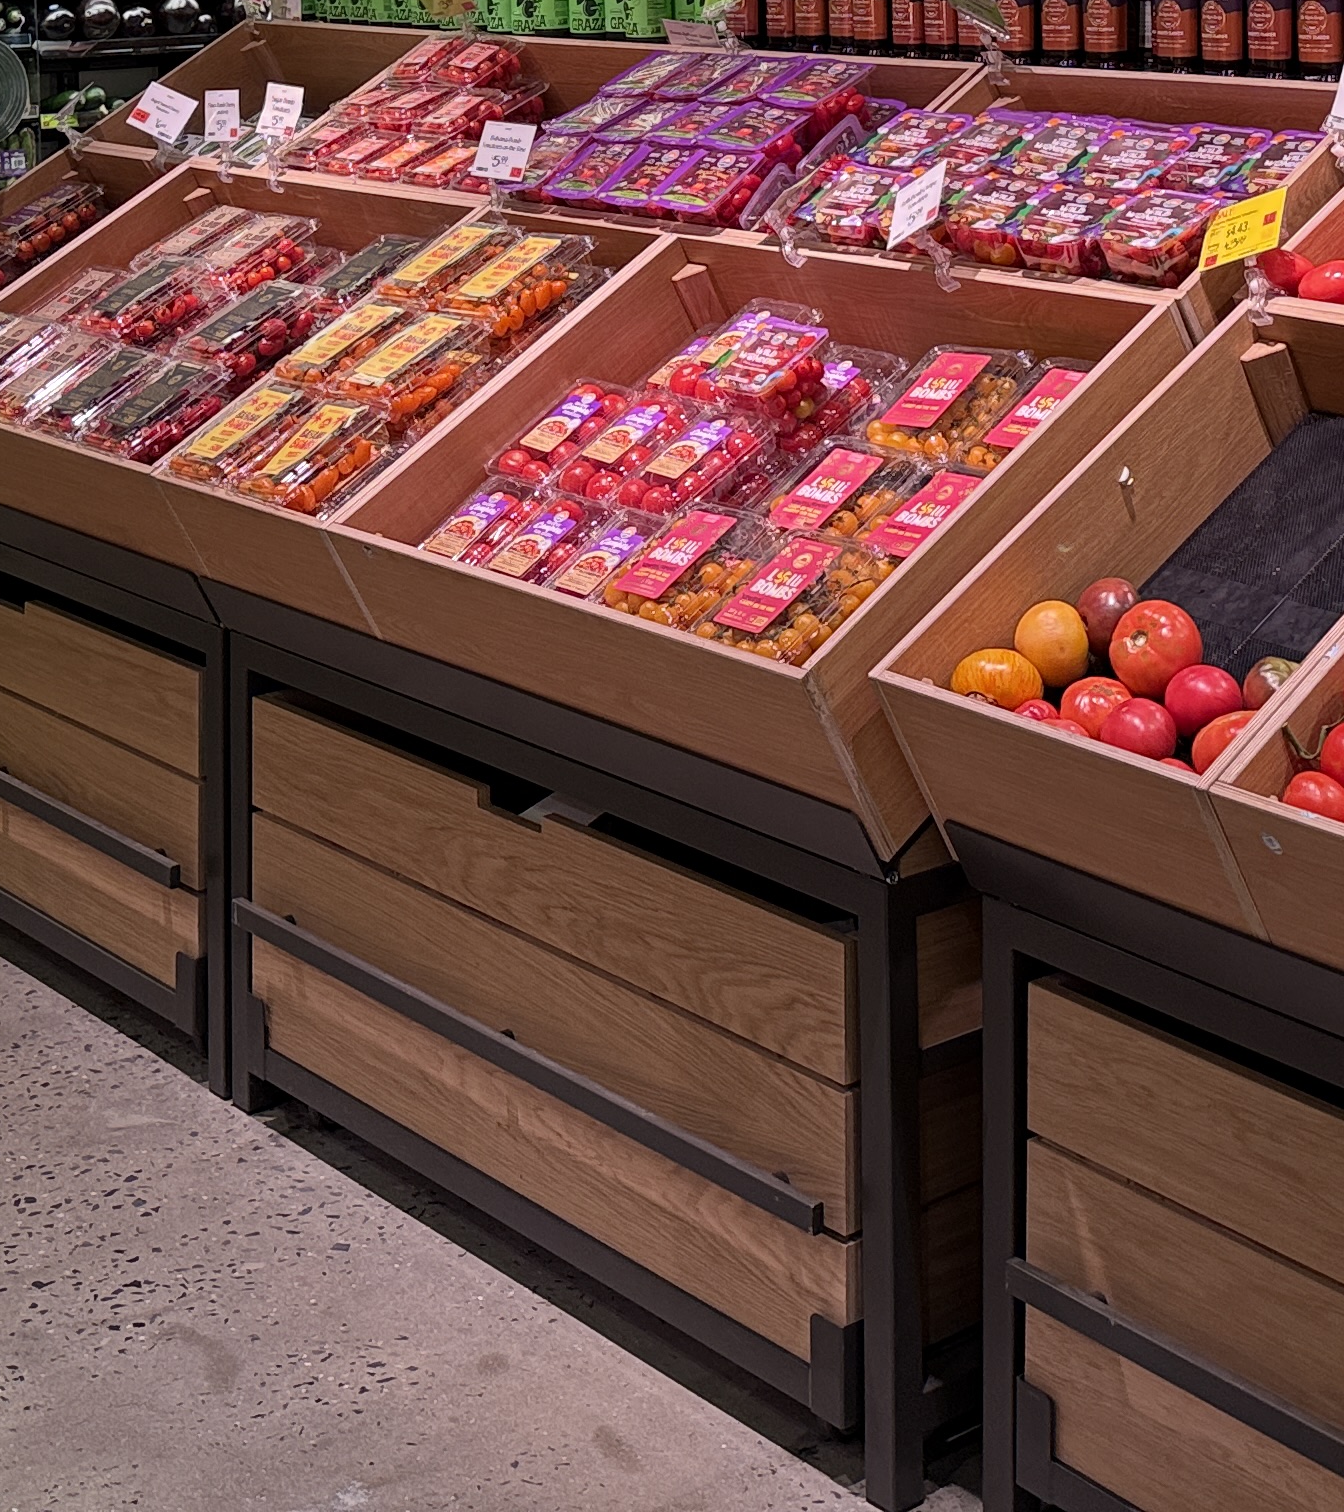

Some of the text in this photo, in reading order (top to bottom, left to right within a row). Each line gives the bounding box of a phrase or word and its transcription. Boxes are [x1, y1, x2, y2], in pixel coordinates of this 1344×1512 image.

[909, 385, 957, 402] BOMBS
[796, 483, 844, 504] BOMBS
[894, 510, 942, 530] BOMBS
[649, 546, 695, 567] BOMBS
[750, 578, 798, 600] BOMBS
